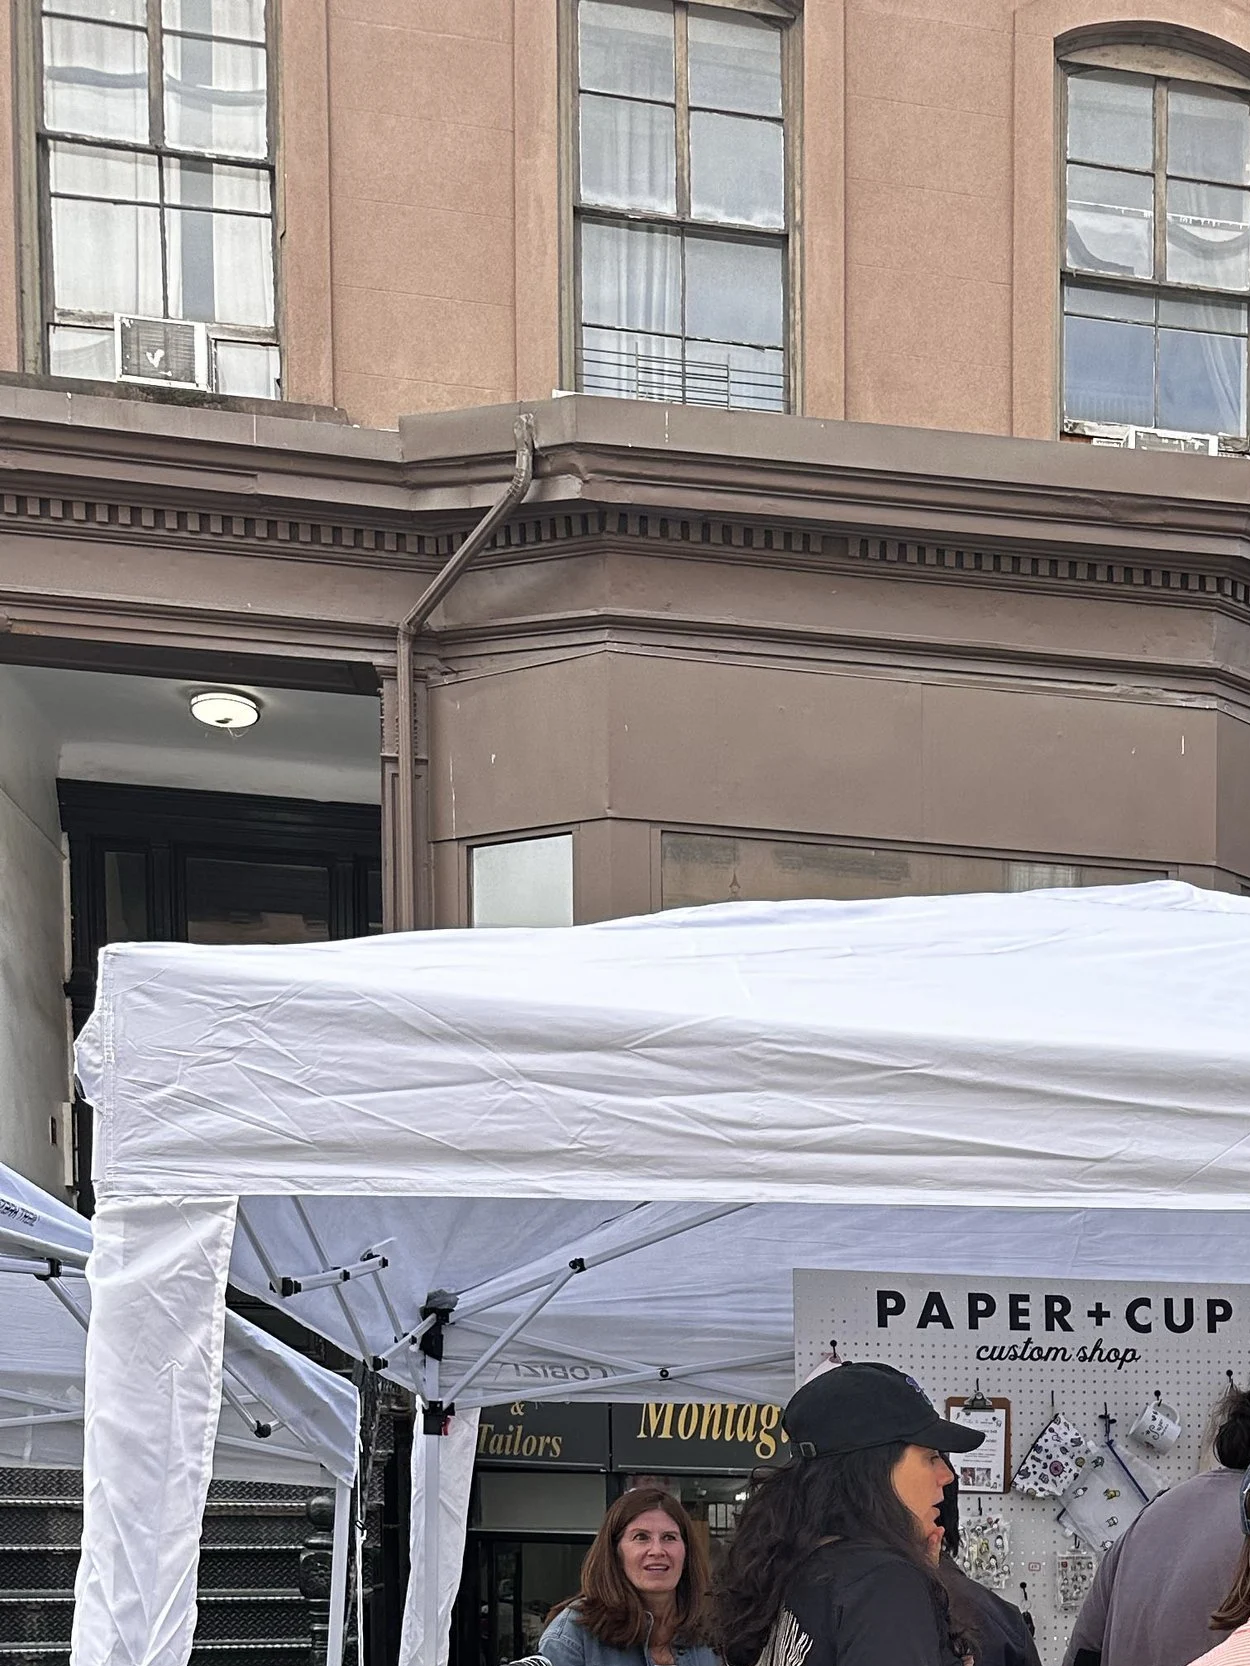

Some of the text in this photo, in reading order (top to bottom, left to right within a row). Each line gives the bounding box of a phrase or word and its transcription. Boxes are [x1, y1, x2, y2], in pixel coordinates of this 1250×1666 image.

[976, 1336, 1142, 1371] custom shop
[477, 1423, 563, 1458] Tailors
